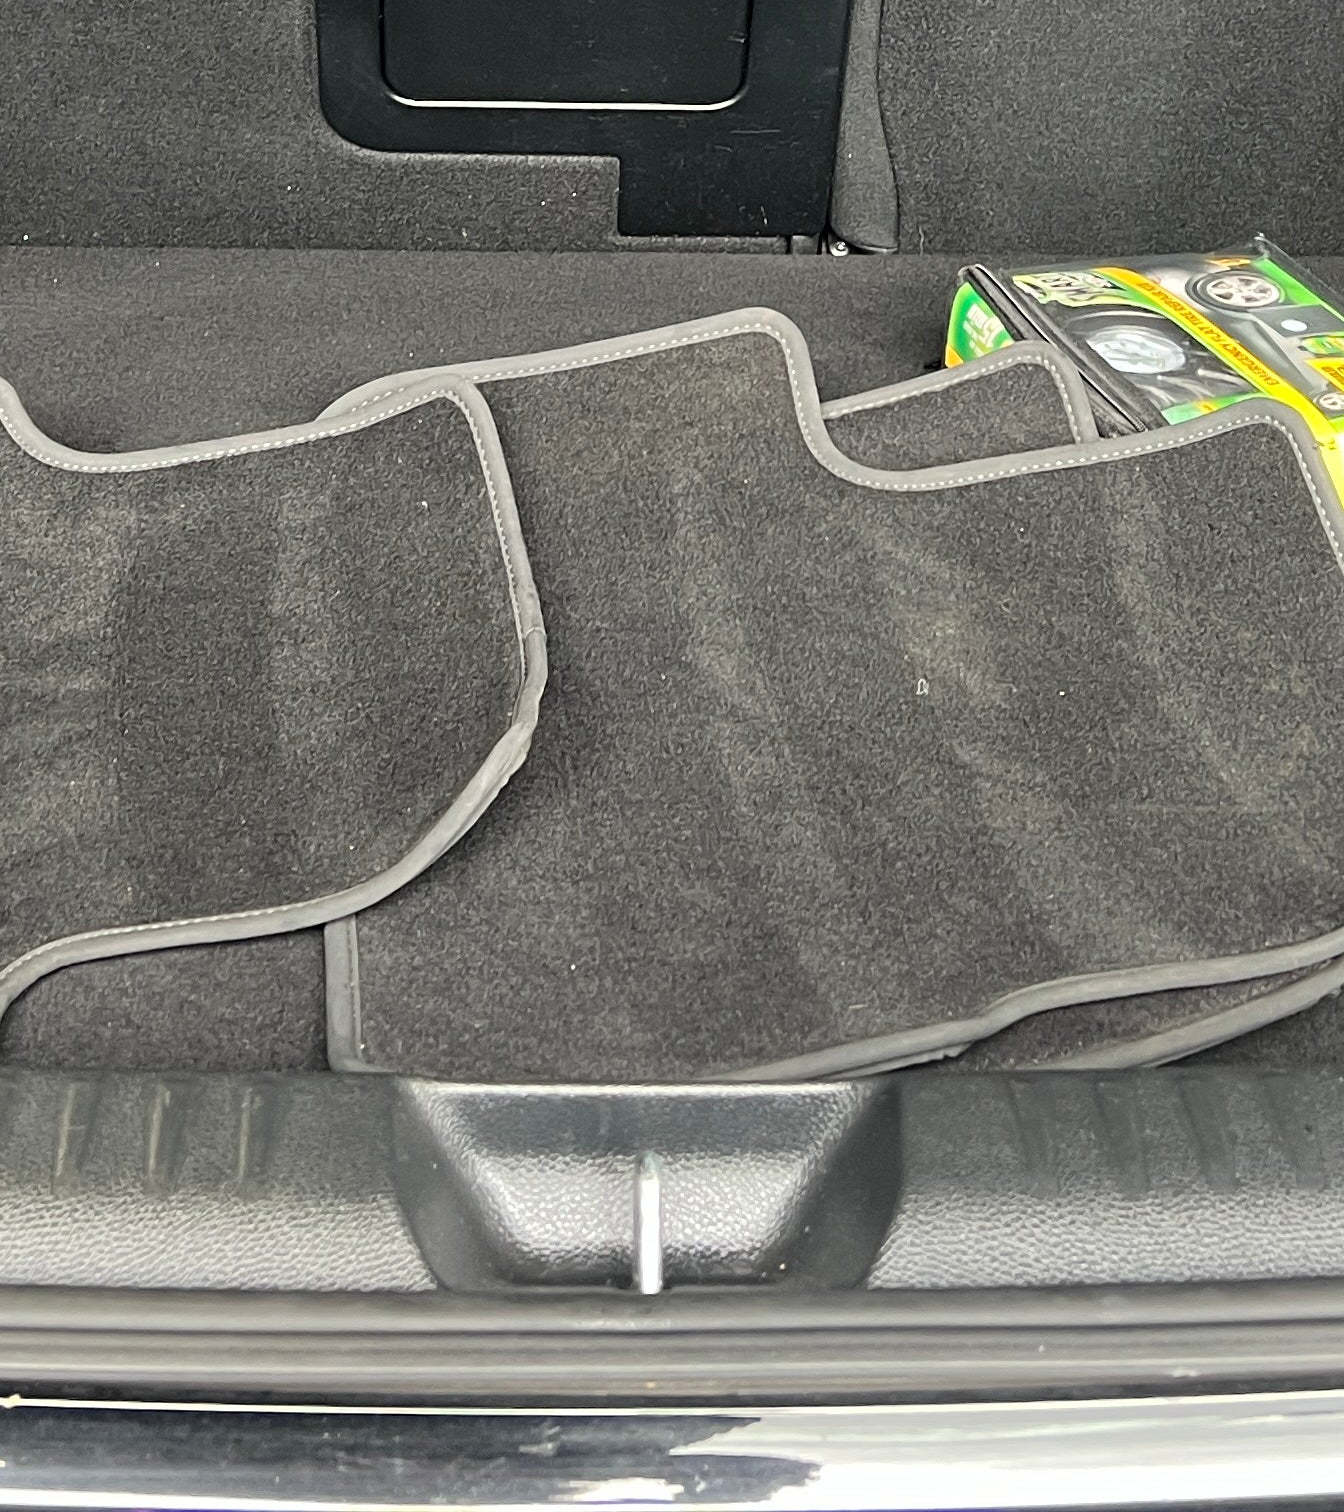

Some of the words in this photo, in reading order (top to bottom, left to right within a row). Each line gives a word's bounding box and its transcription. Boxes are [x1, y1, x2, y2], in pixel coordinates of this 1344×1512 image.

[1151, 291, 1186, 311] REPAIR
[1199, 326, 1225, 343] FLAT
[1220, 343, 1280, 386] EMERGENCY
